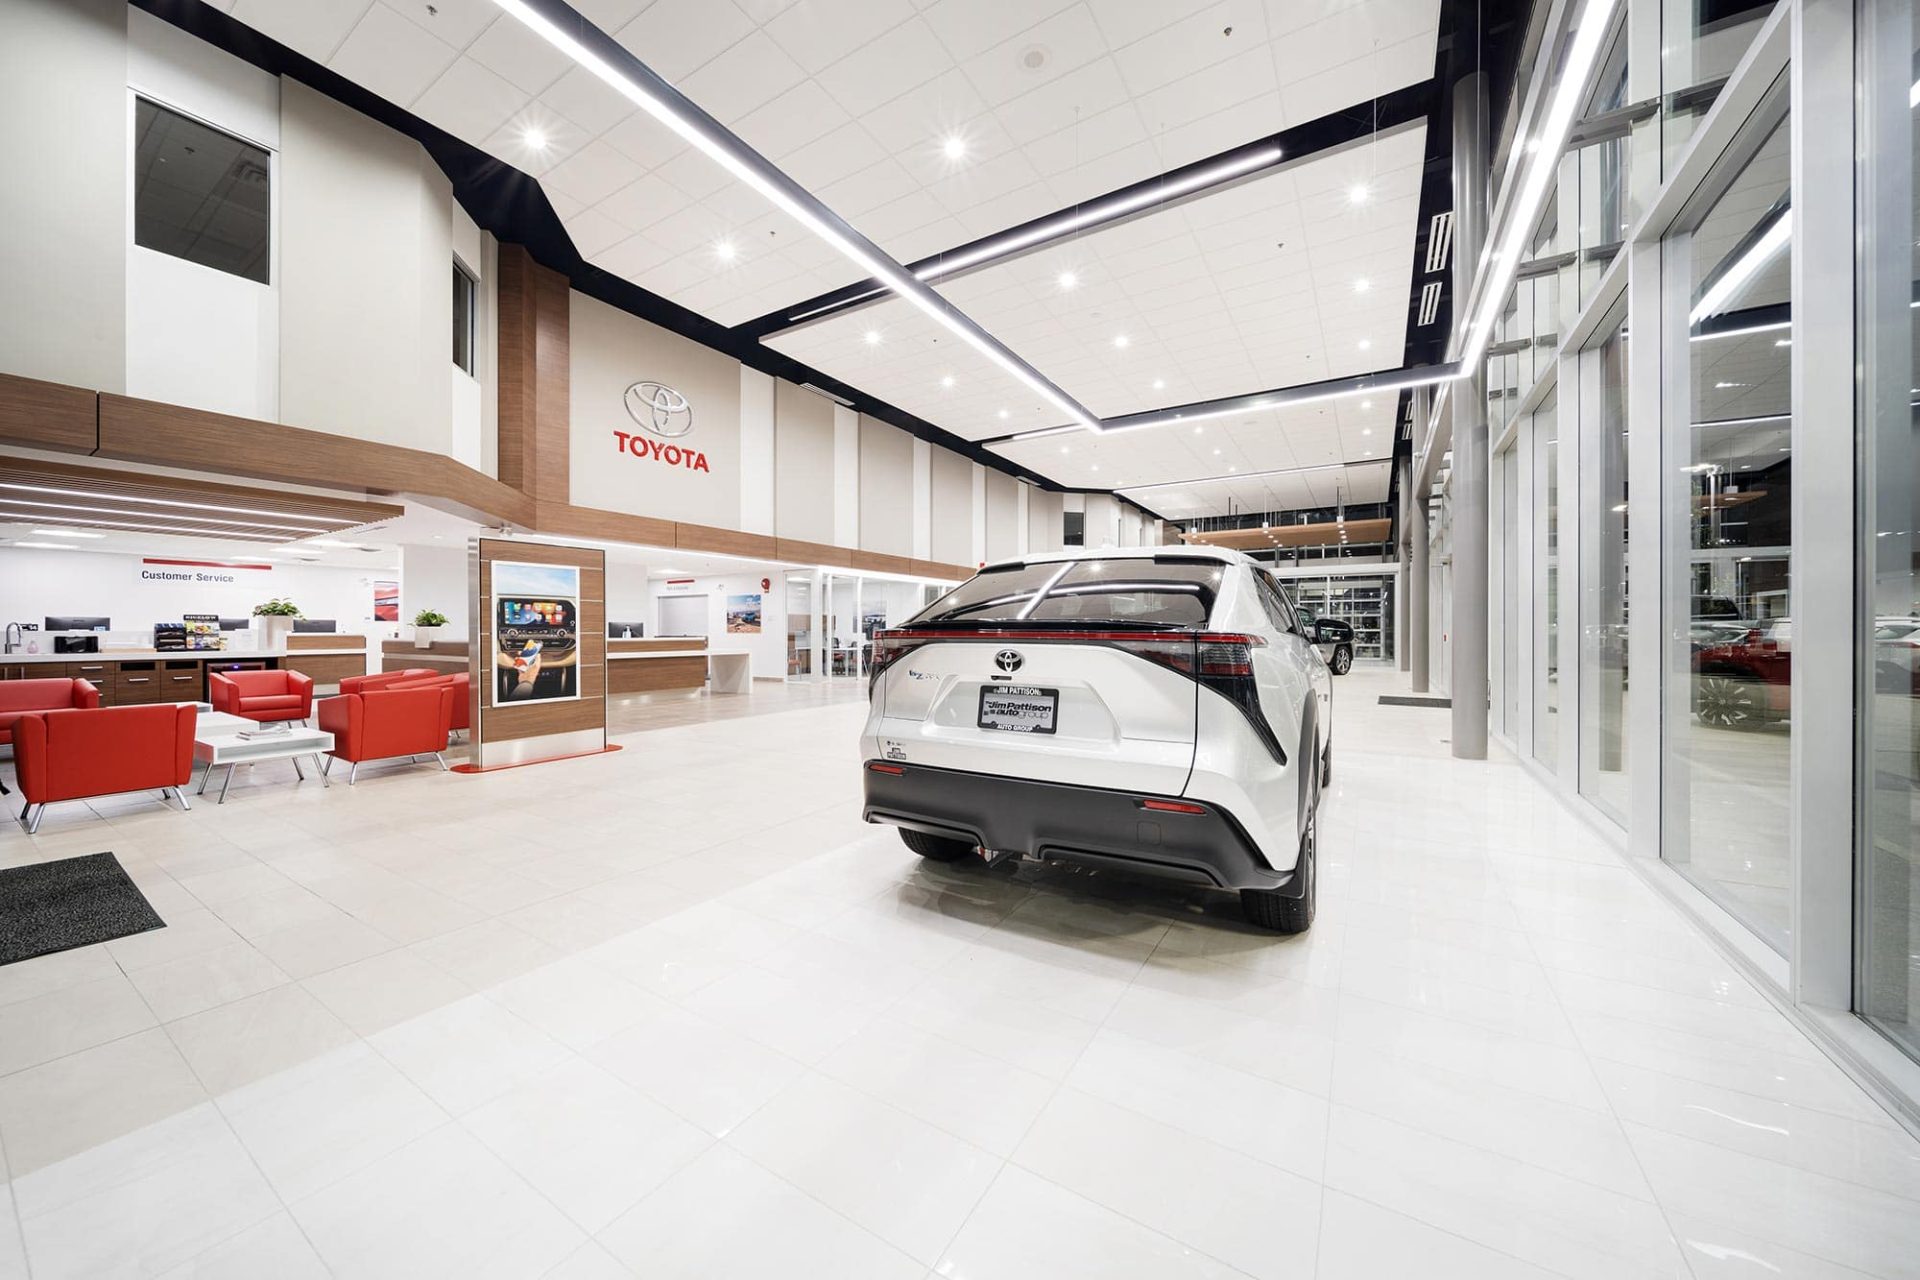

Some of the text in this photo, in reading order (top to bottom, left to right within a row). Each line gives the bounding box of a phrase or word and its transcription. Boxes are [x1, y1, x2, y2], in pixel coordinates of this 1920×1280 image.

[613, 430, 710, 473] TOYOTA
[141, 570, 234, 582] Customer Service
[997, 686, 1039, 696] JIM PATTISON
[988, 701, 1006, 709] Jim
[1007, 702, 1052, 712] Pattison
